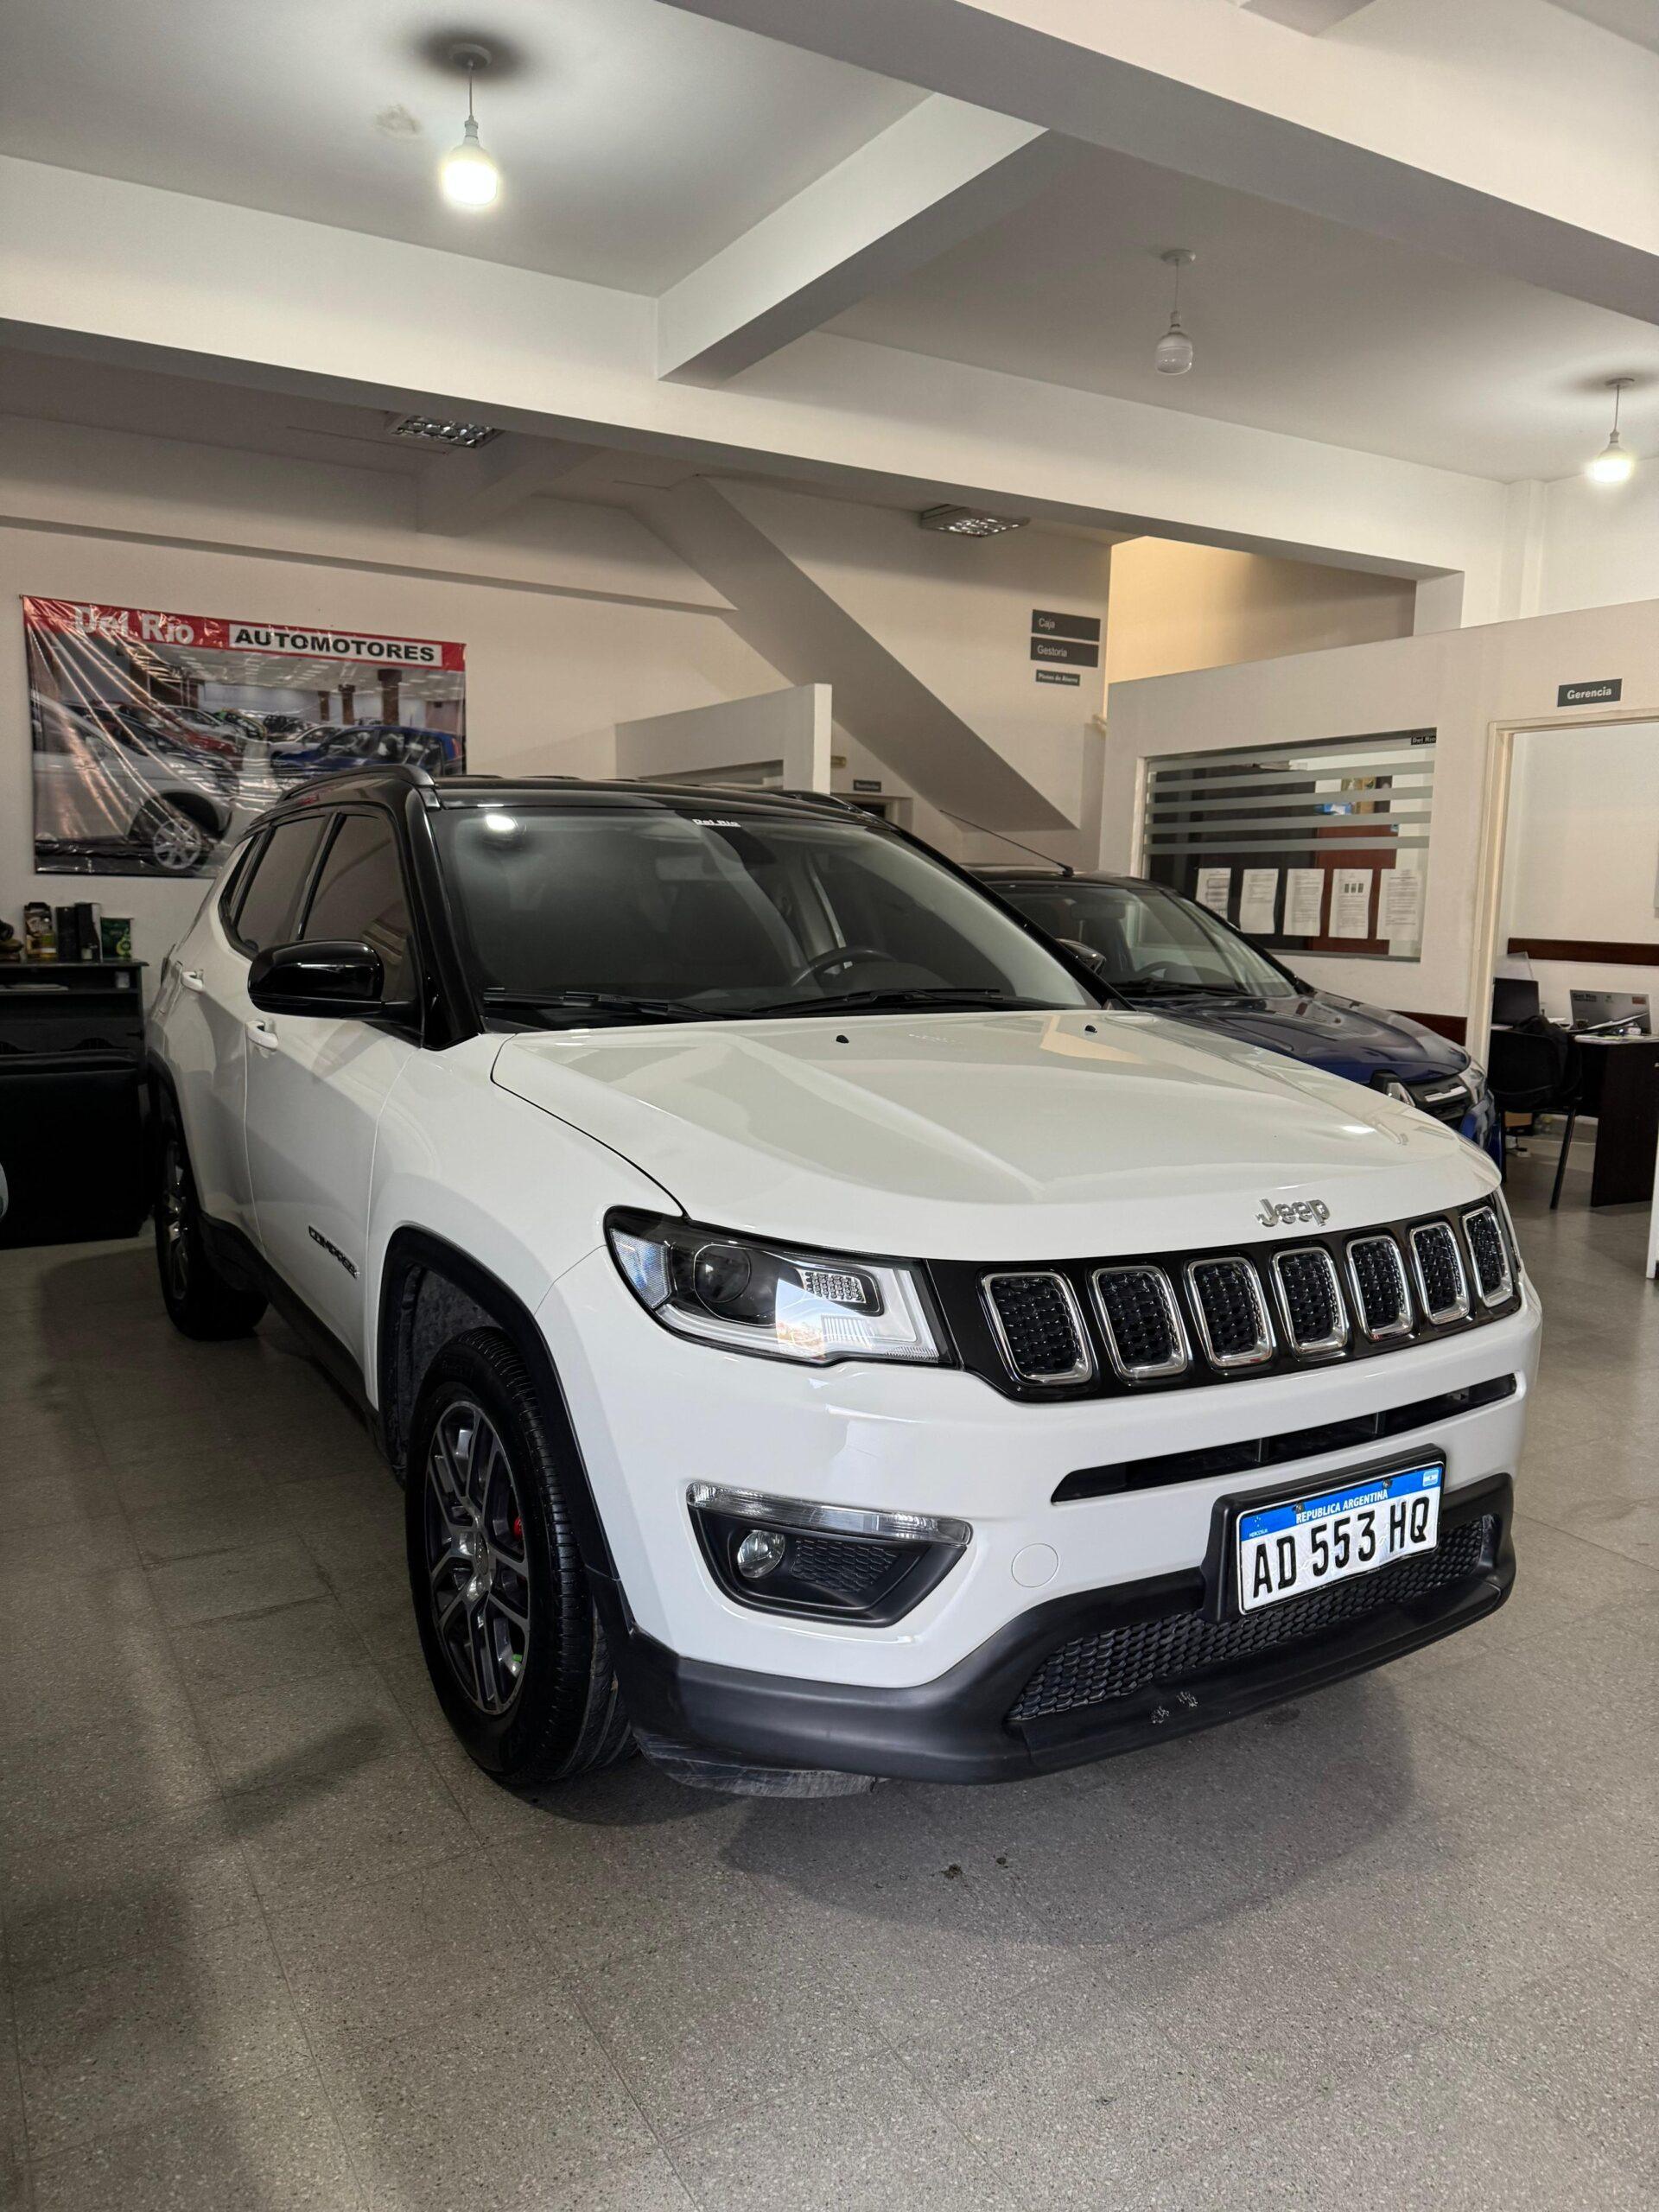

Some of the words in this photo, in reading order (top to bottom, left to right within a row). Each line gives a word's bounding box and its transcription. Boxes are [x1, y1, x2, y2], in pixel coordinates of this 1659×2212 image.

[1039, 618, 1055, 630] Caja
[235, 629, 435, 662] AUTOMOTORES
[1567, 687, 1612, 700] Gerencia
[1255, 1198, 1331, 1227] Jeep
[1296, 1503, 1341, 1524] REPUBLICA
[1342, 1489, 1389, 1512] ARGENTINA
[1253, 1535, 1296, 1599] AD
[1311, 1510, 1376, 1577] 553
[1389, 1496, 1430, 1553] HQ
